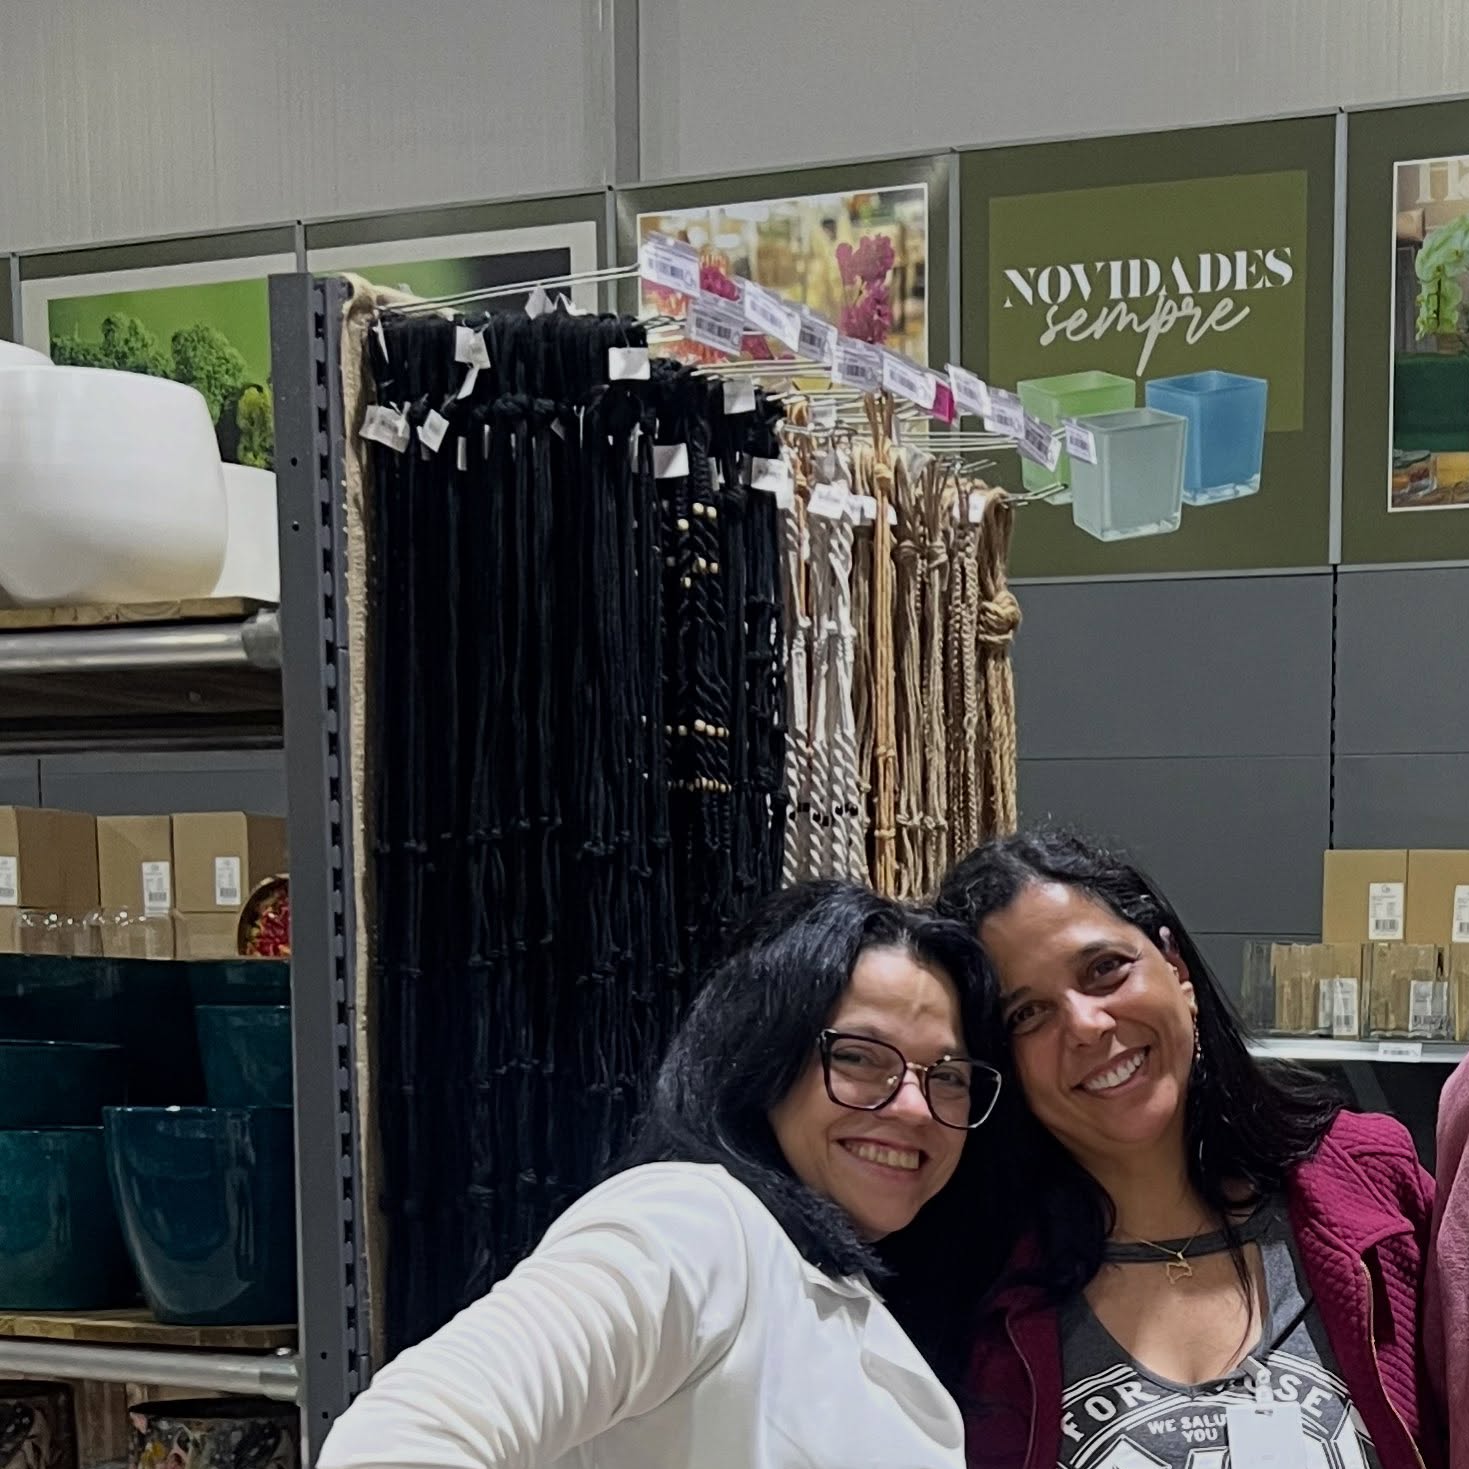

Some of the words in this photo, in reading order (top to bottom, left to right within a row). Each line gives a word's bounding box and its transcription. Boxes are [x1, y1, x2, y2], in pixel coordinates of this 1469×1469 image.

[1002, 247, 1294, 308] NOVIDADES
[1038, 294, 1250, 377] sempre
[1060, 1381, 1160, 1443] FOR
[1147, 1418, 1177, 1435] WE
[1179, 1413, 1228, 1430] SALU
[1181, 1427, 1219, 1443] YOU
